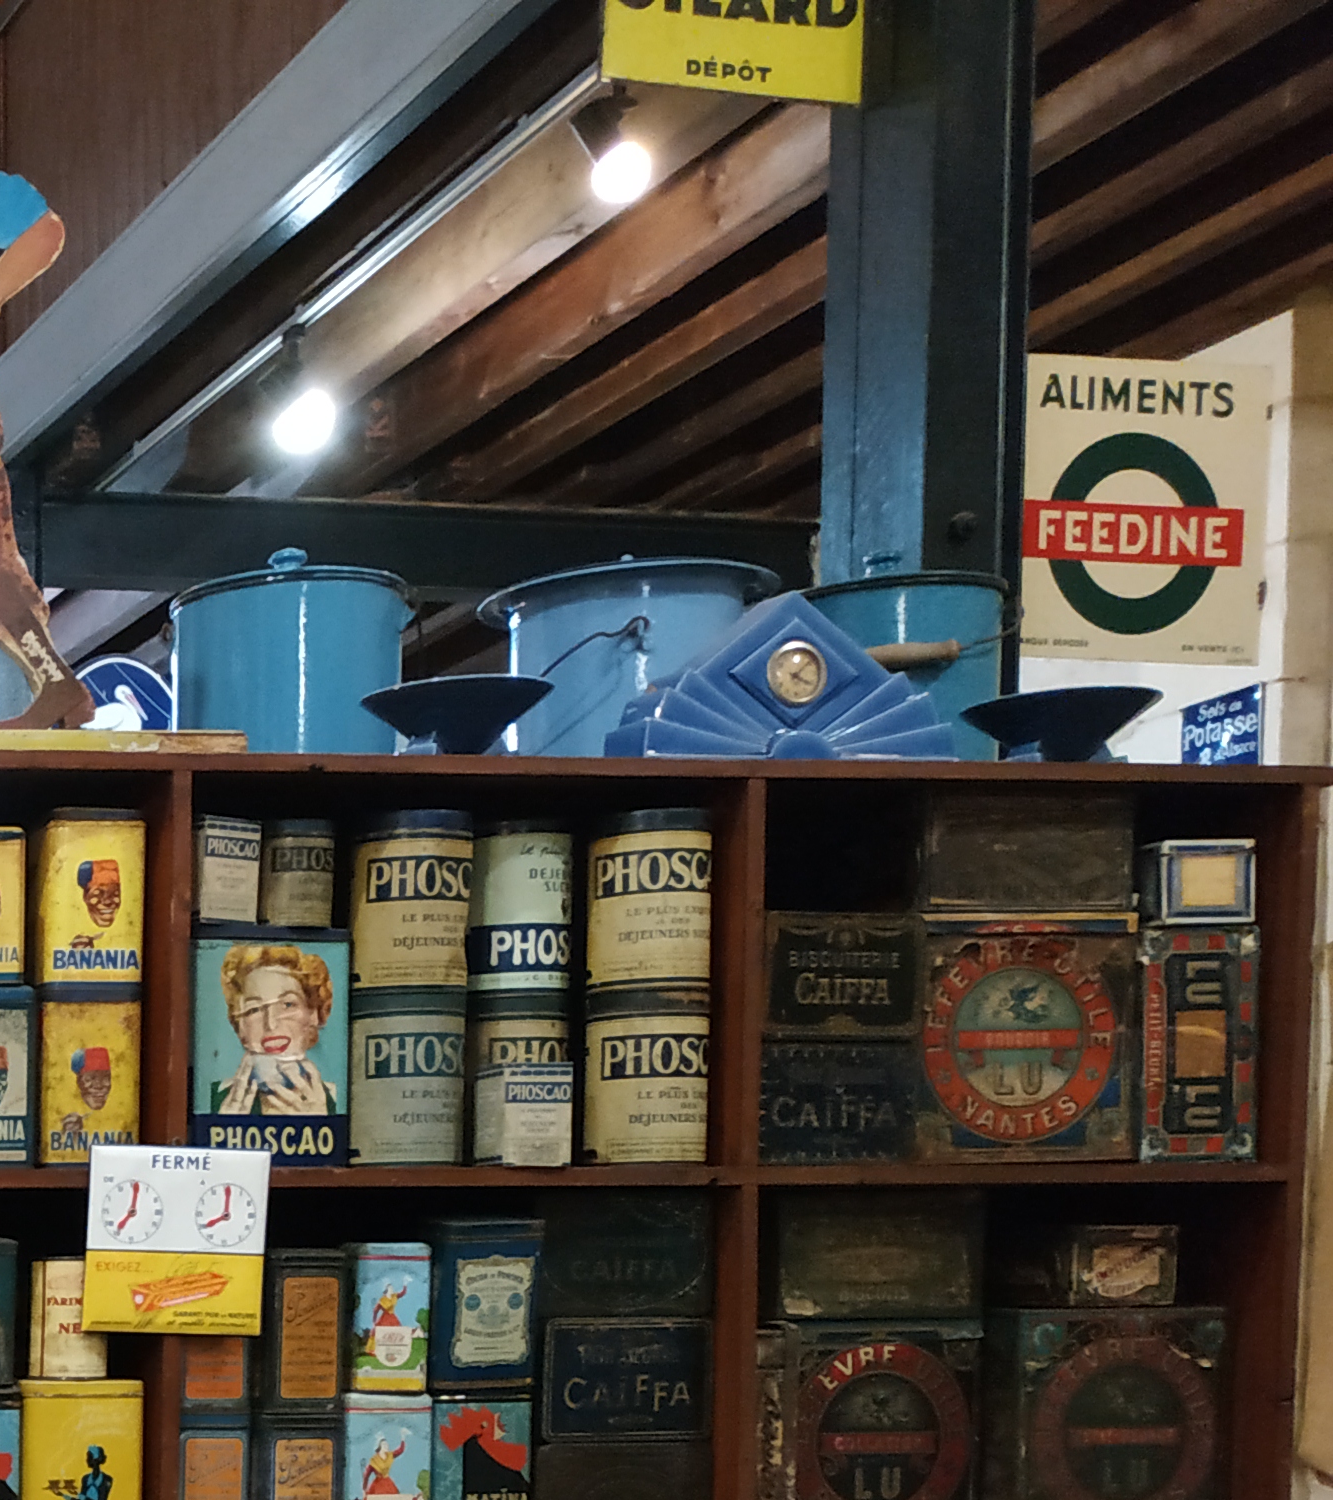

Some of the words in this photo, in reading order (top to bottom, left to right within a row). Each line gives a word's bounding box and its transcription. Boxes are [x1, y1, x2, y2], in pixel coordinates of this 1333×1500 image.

[686, 56, 772, 82] DÉPÔT
[1040, 372, 1235, 419] ALIMENTS
[1037, 509, 1229, 559] FEEDINE
[1183, 713, 1258, 751] Potasse
[206, 837, 259, 858] PHOSCAO
[369, 860, 473, 900] PHOSC
[52, 948, 140, 971] BANANIA
[602, 1036, 708, 1078] PHOSC
[508, 1085, 571, 1100] PHOSCAO
[993, 1062, 1043, 1096] LU
[963, 1094, 1079, 1135] NANTES
[49, 1131, 134, 1151] BANANIA
[209, 1126, 334, 1156] PHOSCAO
[151, 1153, 211, 1171] FERMÉ
